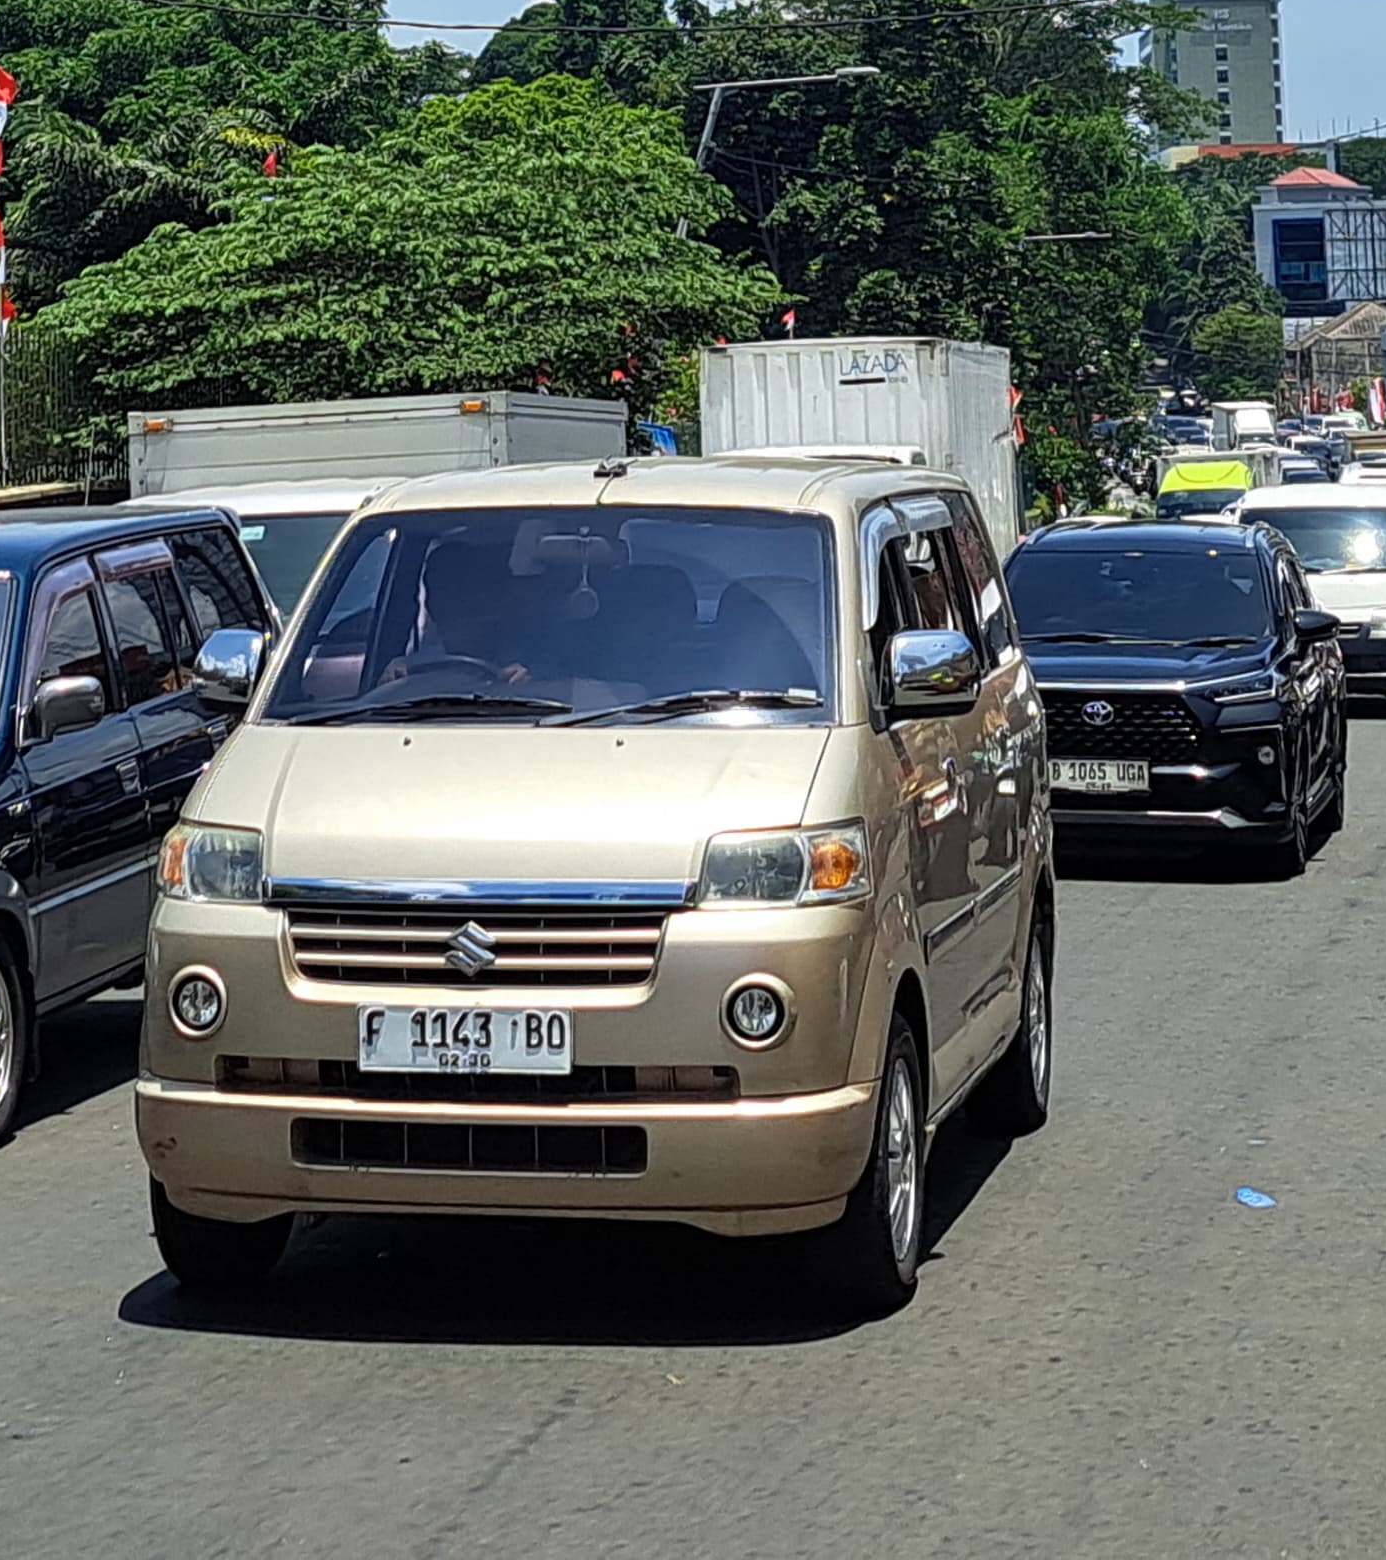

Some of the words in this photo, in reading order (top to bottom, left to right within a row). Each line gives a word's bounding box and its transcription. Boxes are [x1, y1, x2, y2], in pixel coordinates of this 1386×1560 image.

[839, 352, 908, 376] LAZADA
[1052, 762, 1061, 781] B
[1068, 762, 1106, 781] 1065
[1116, 763, 1145, 782] UGA
[366, 1010, 384, 1047] F
[411, 1010, 491, 1048] 1143
